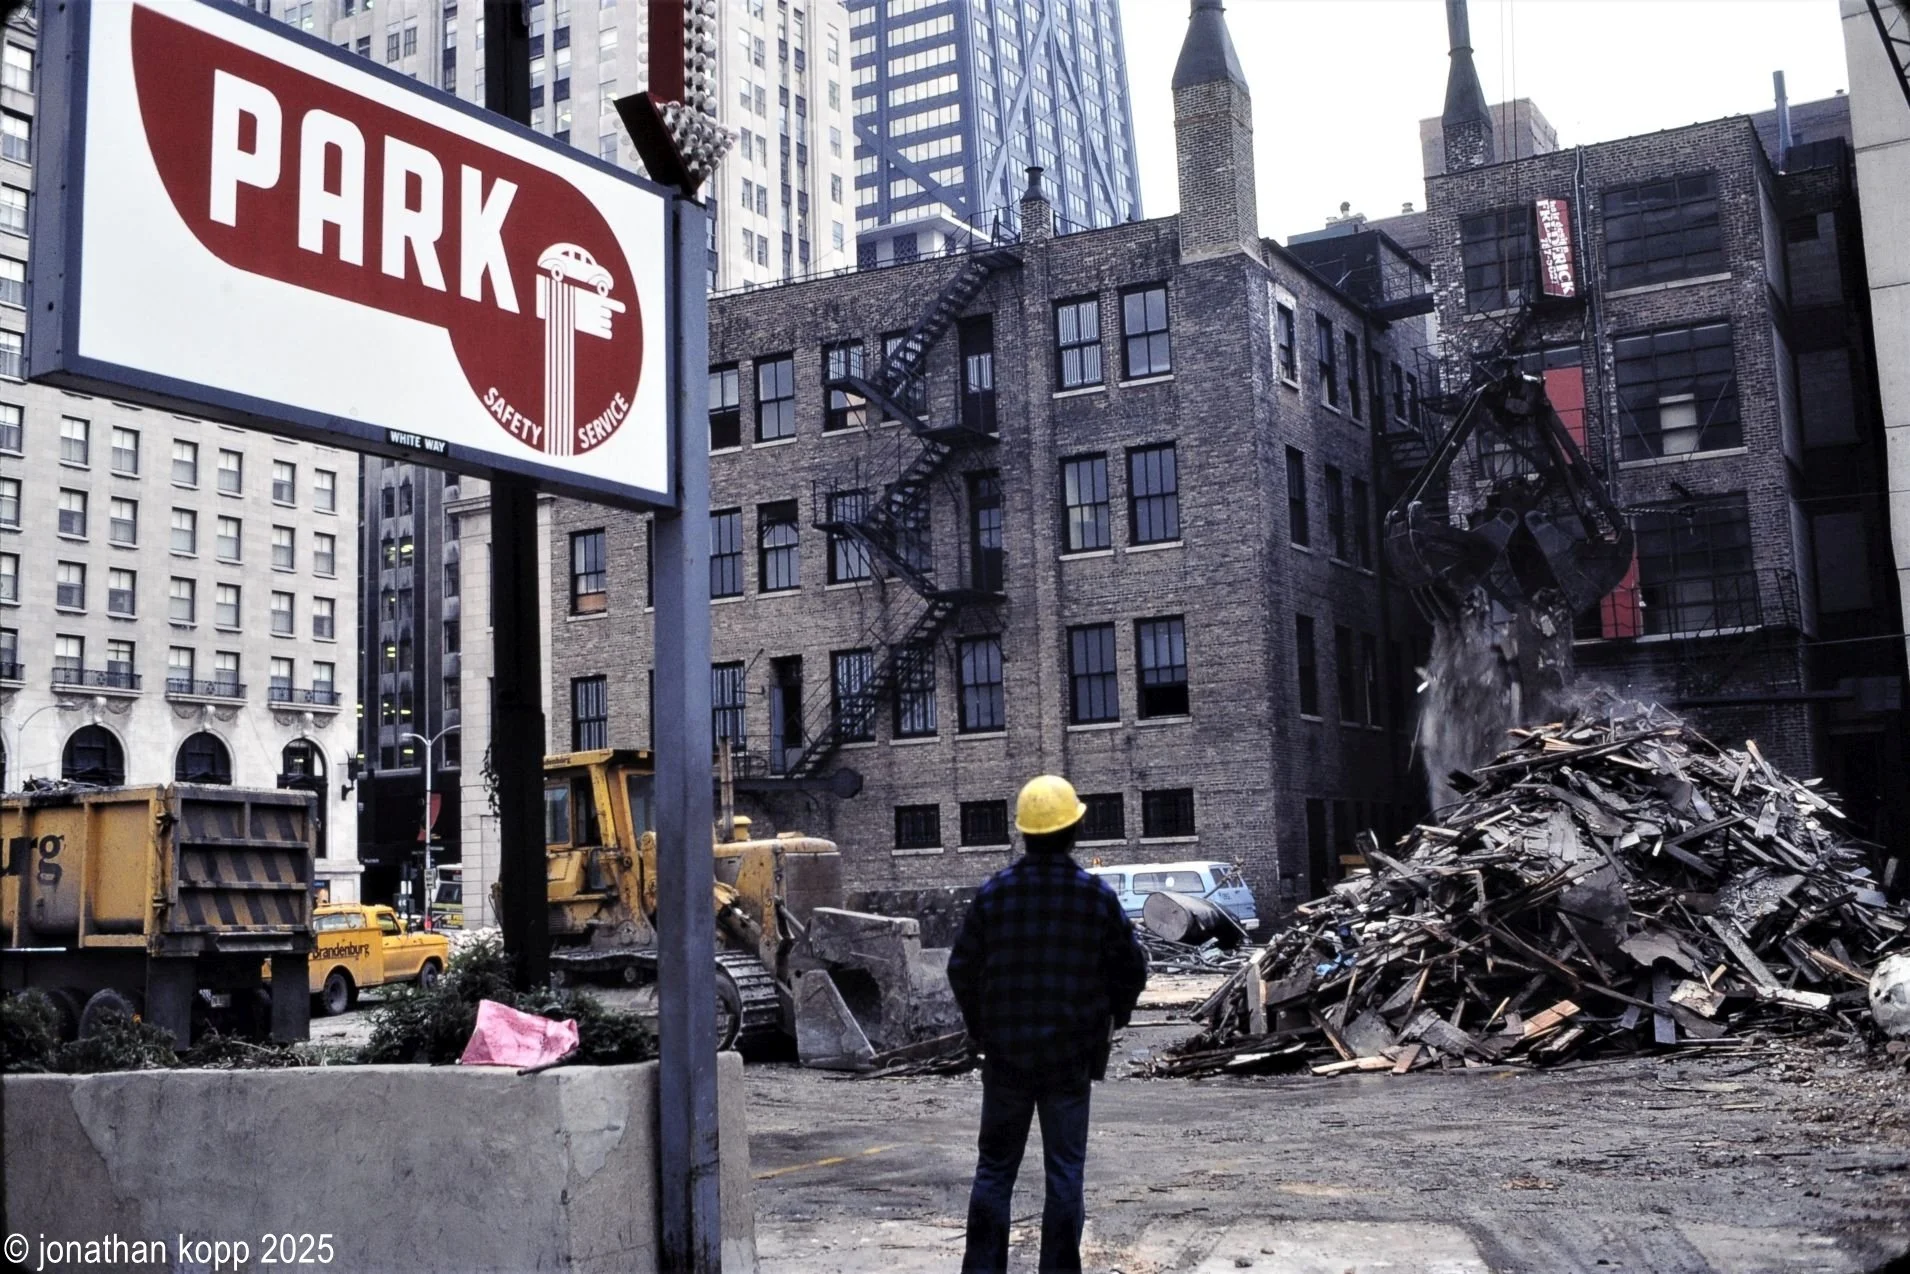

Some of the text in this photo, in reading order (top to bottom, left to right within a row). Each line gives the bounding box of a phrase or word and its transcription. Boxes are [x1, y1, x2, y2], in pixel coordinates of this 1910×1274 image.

[210, 68, 519, 314] PARK
[1537, 200, 1575, 295] FREDERICK
[390, 430, 446, 453] WHITE WAY
[484, 387, 629, 448] SAFETY SERVICE
